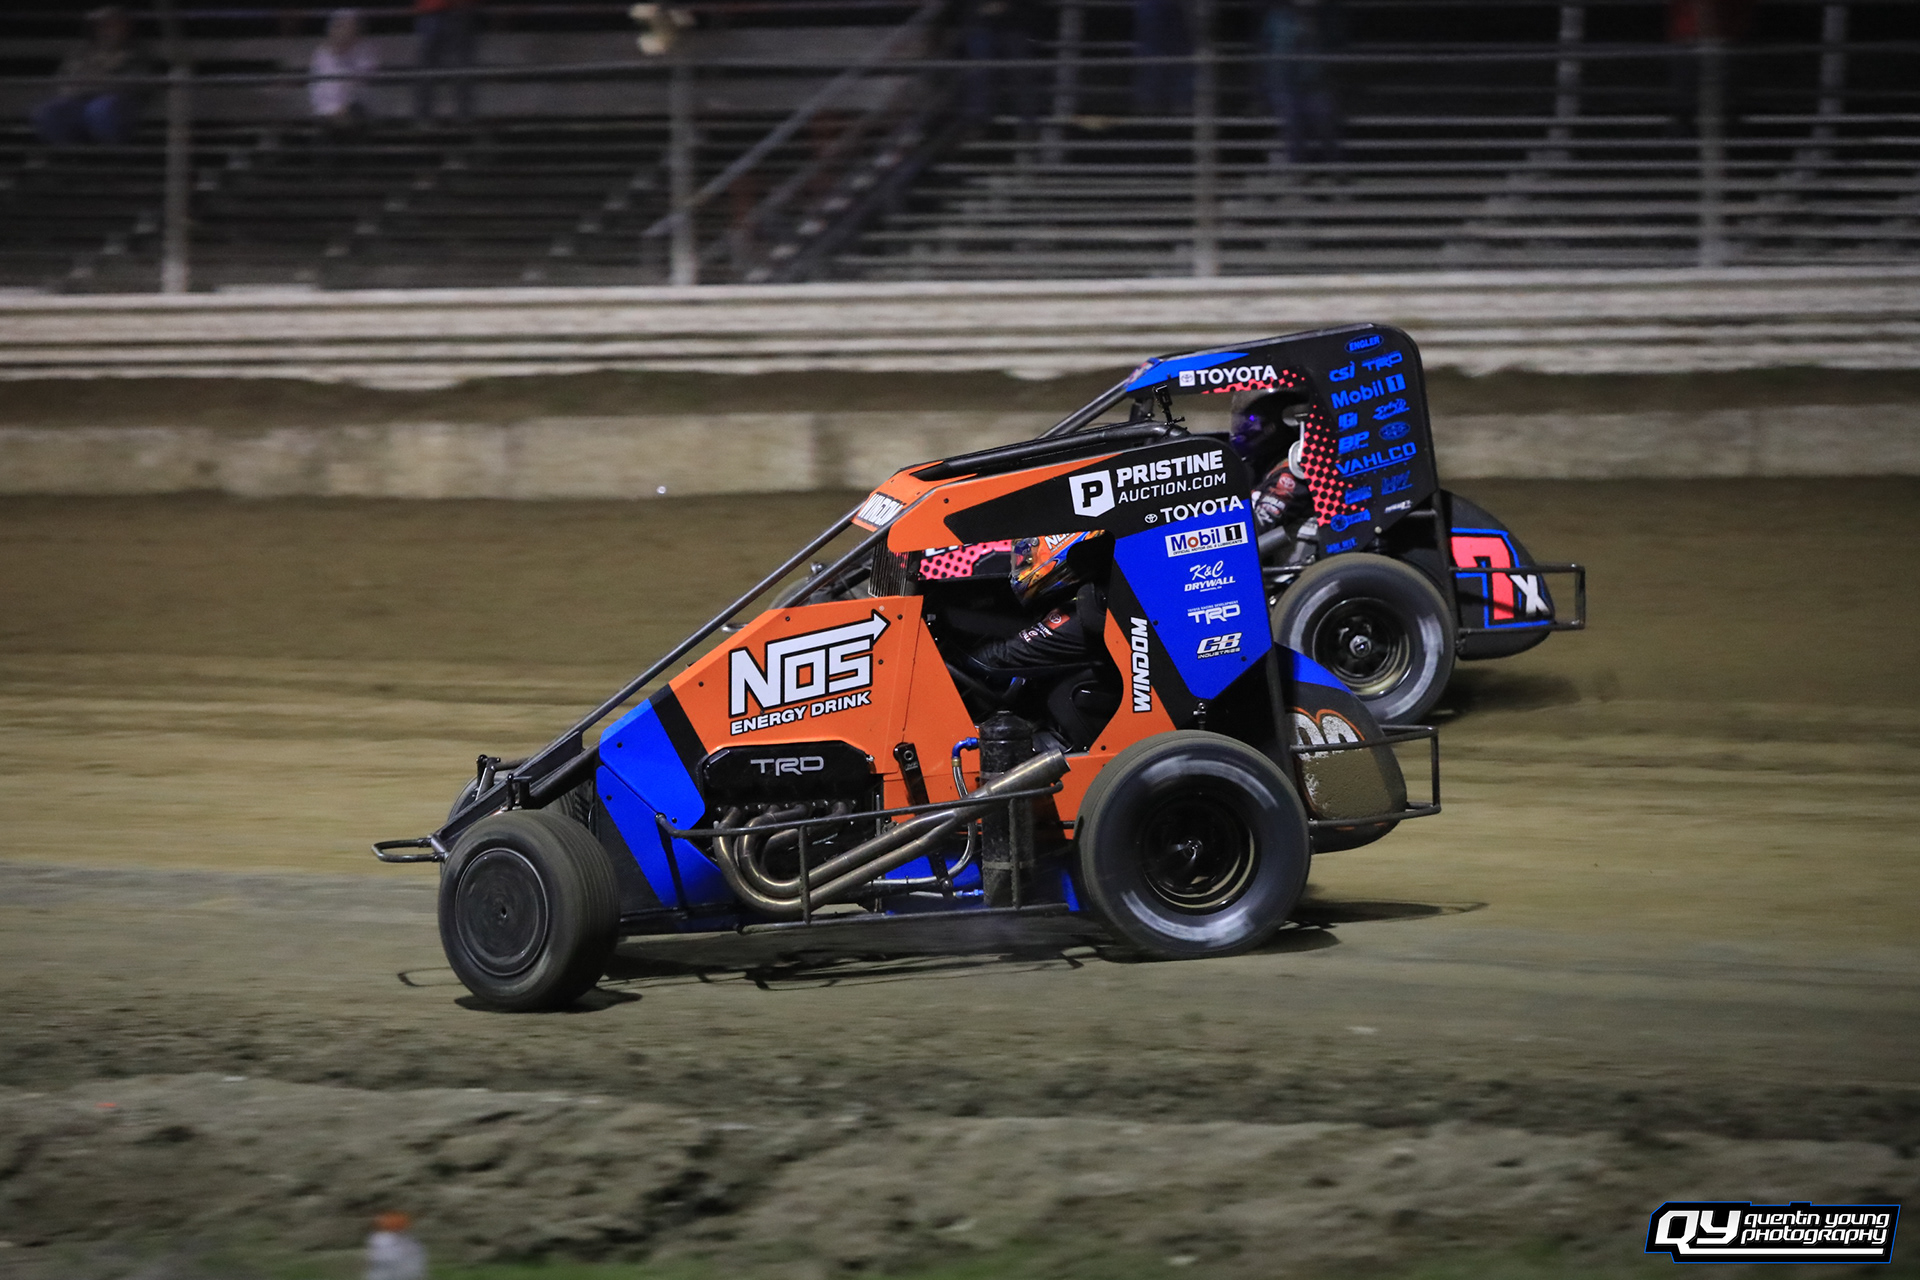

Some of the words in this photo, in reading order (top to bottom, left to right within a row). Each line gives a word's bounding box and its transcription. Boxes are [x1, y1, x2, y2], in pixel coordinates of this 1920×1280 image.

[1349, 336, 1380, 352] ENGLER
[1362, 351, 1402, 371] TRD
[1196, 365, 1278, 385] TOYOTA
[1331, 380, 1384, 409] Mobil
[1116, 450, 1224, 488] PRISTINE
[1335, 442, 1416, 475] VAHLCO
[1118, 472, 1226, 504] AUCTION.COM
[1160, 496, 1244, 523] TOYOTA
[1170, 528, 1220, 551] Mobil
[1190, 560, 1224, 581] K&C
[1184, 576, 1236, 592] DRYWALL
[1188, 604, 1240, 624] TRD
[1130, 616, 1151, 712] WINDOM
[1198, 648, 1240, 660] INDUSTRIES
[730, 630, 878, 717] NOS
[730, 707, 807, 736] ENERGY
[811, 692, 871, 718] DRINK
[750, 755, 825, 776] TRD
